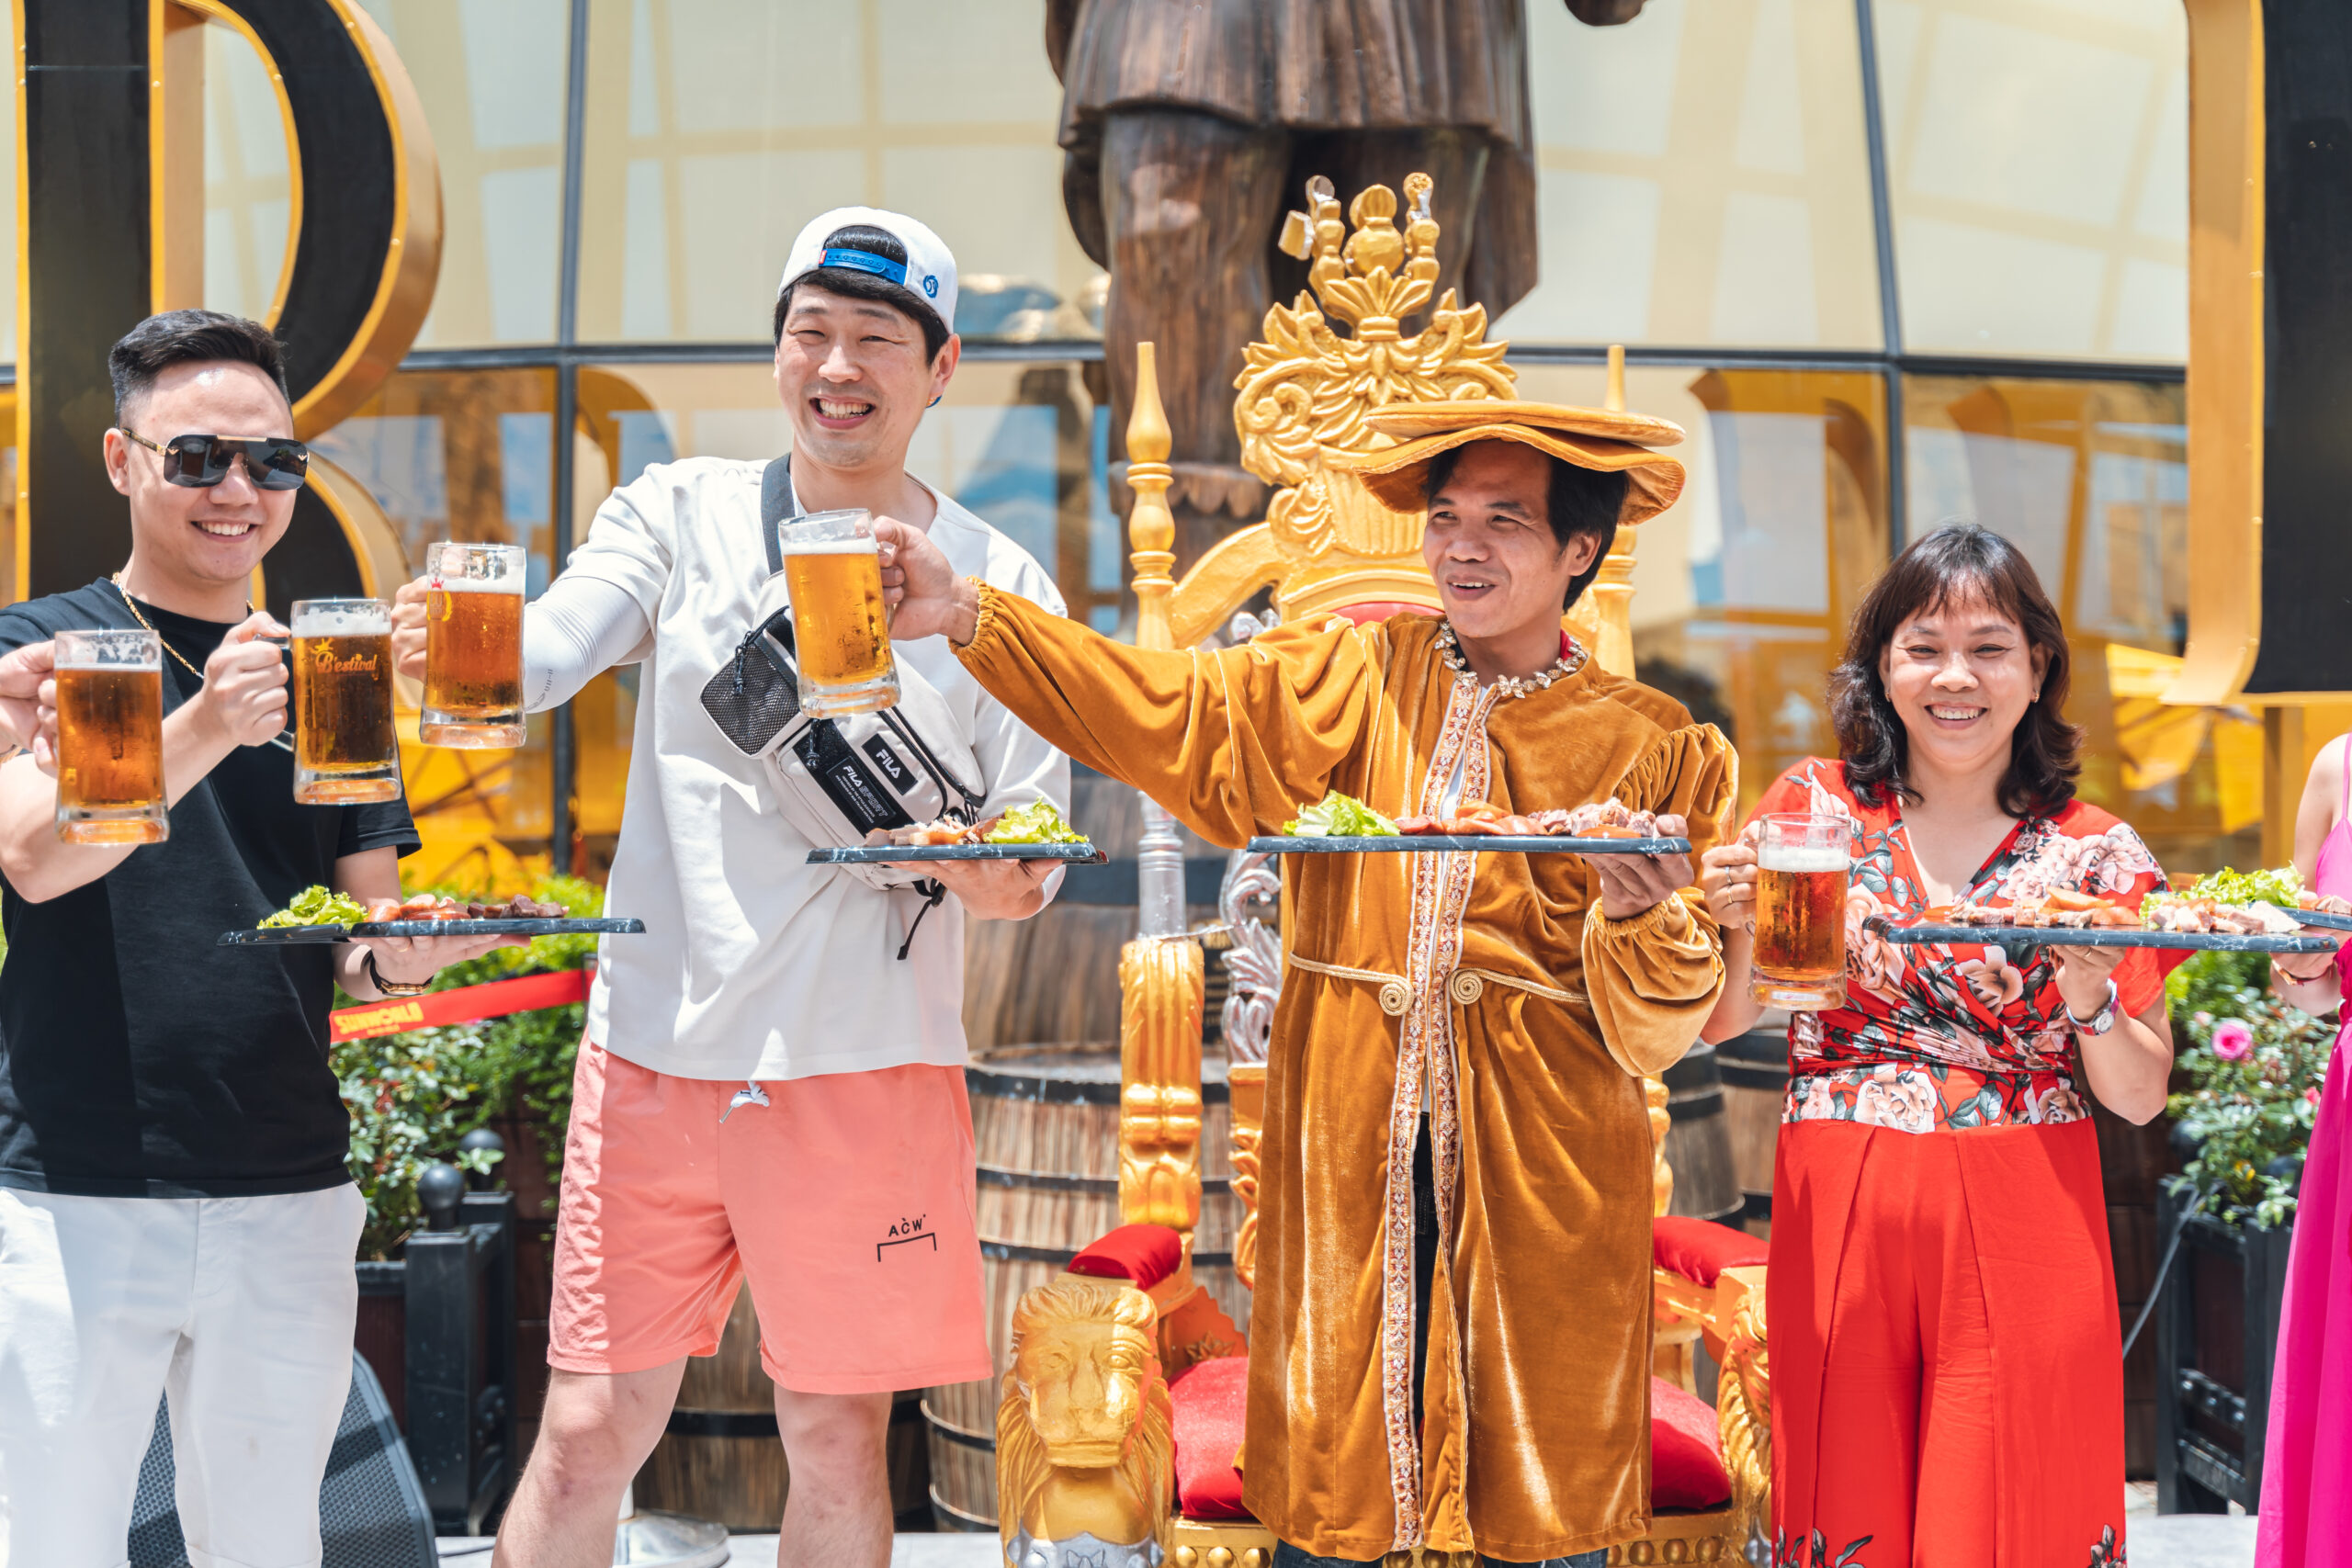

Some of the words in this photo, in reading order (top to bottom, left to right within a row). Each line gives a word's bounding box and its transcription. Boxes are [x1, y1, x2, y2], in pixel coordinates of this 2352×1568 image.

[876, 749, 900, 779] FILA
[842, 765, 863, 787] FILA
[859, 785, 888, 817] SPORT
